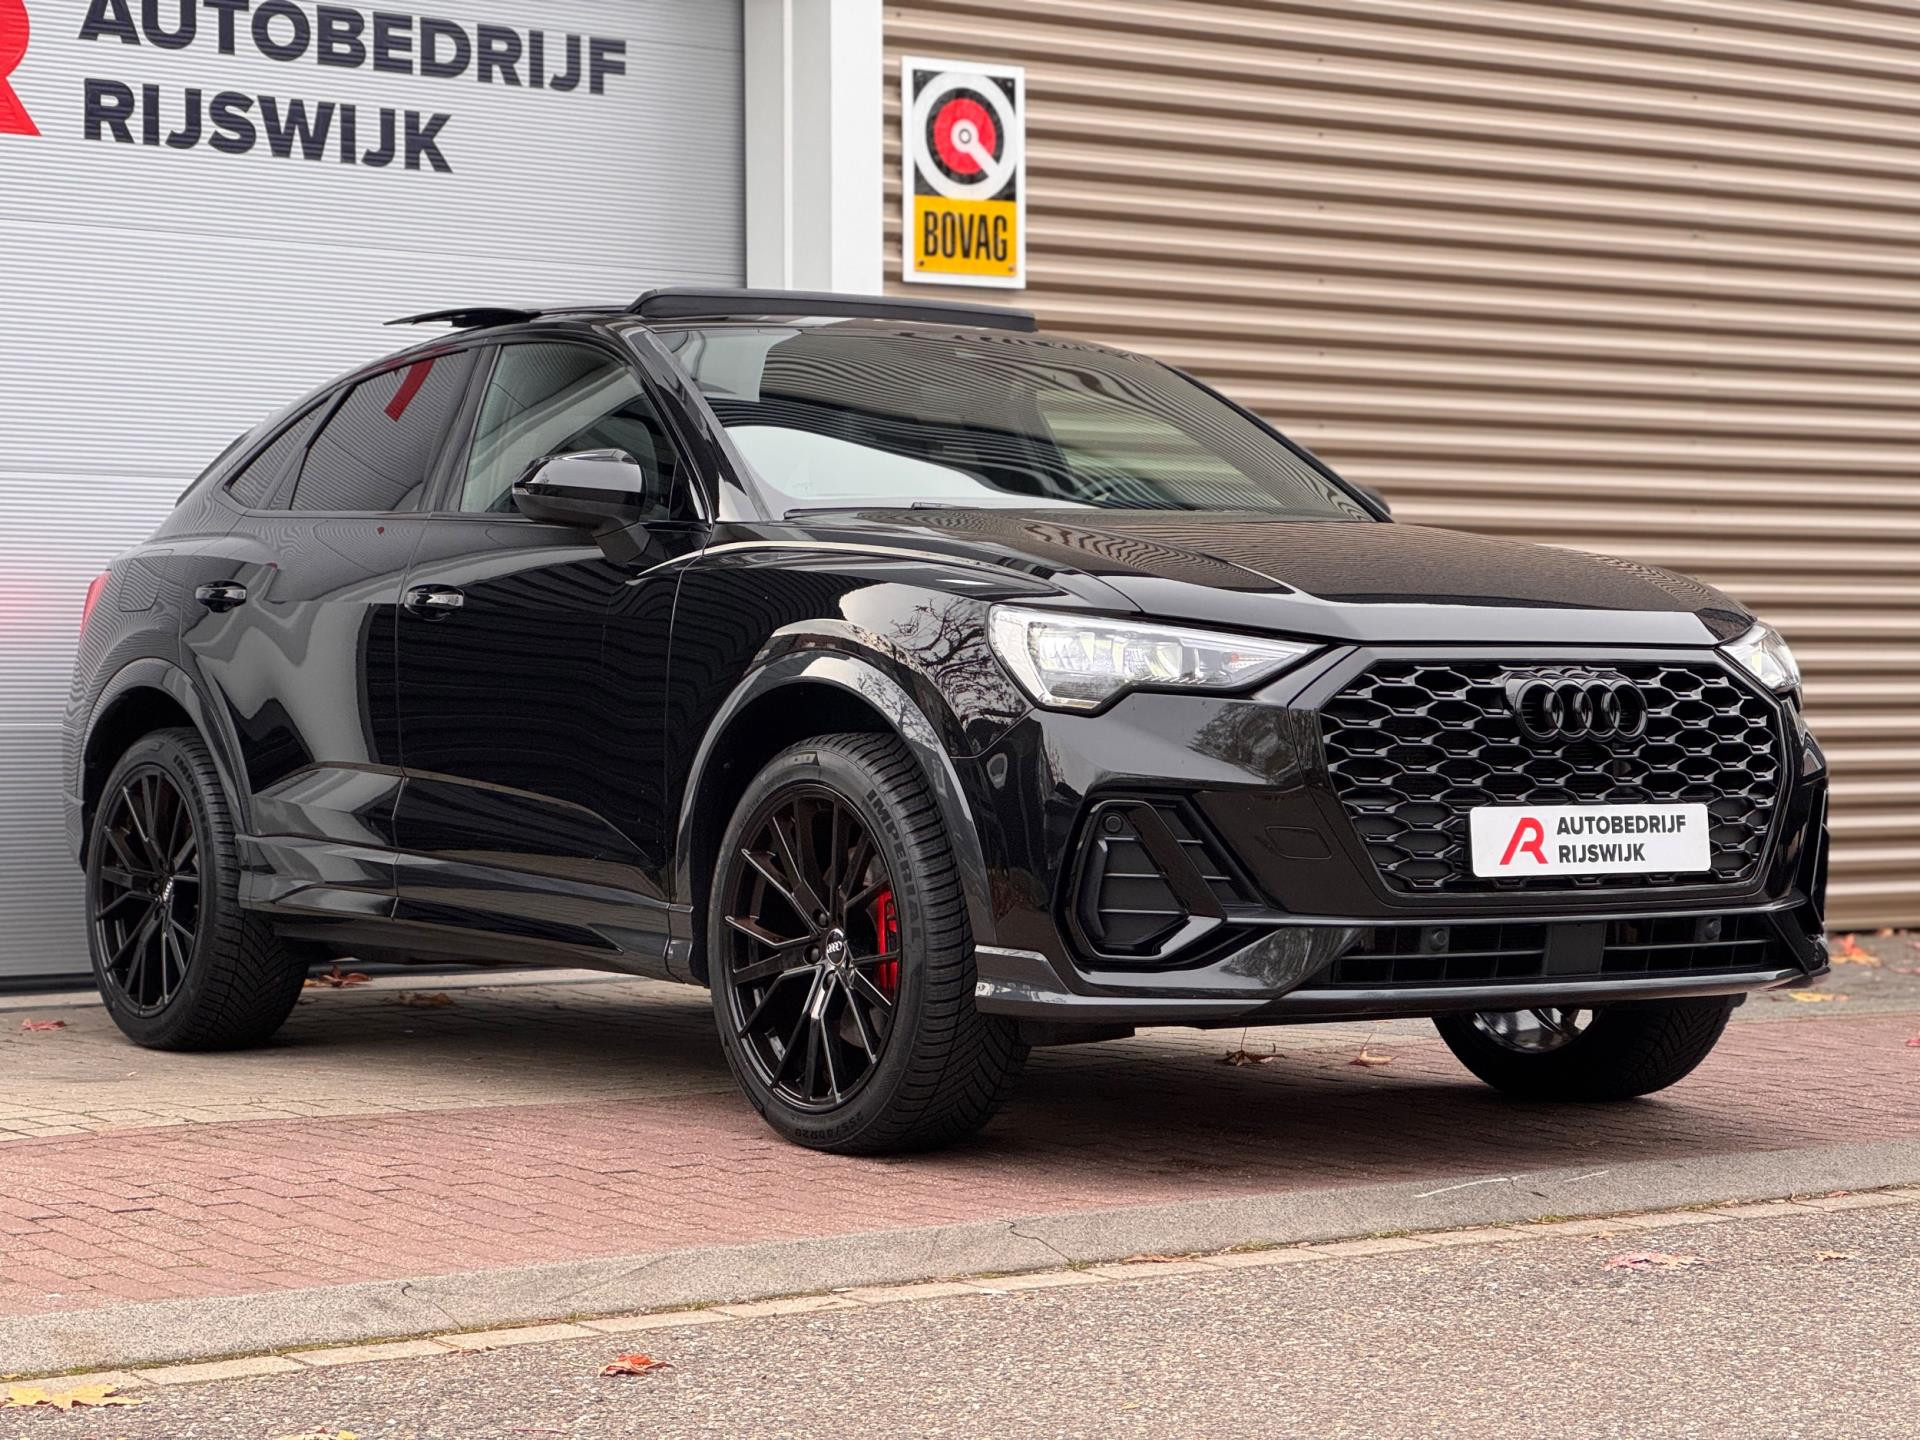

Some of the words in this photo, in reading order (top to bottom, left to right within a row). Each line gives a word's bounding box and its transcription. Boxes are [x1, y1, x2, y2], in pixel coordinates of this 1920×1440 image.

[78, 0, 627, 96] AUTOBEDRIJF
[83, 77, 454, 174] RIJSWIJK
[923, 210, 1008, 262] BOVAG
[1556, 814, 1687, 836] AUTOBEDRIJF
[1558, 843, 1646, 864] RIJSWIJK
[866, 788, 921, 942] IMPERIAL
